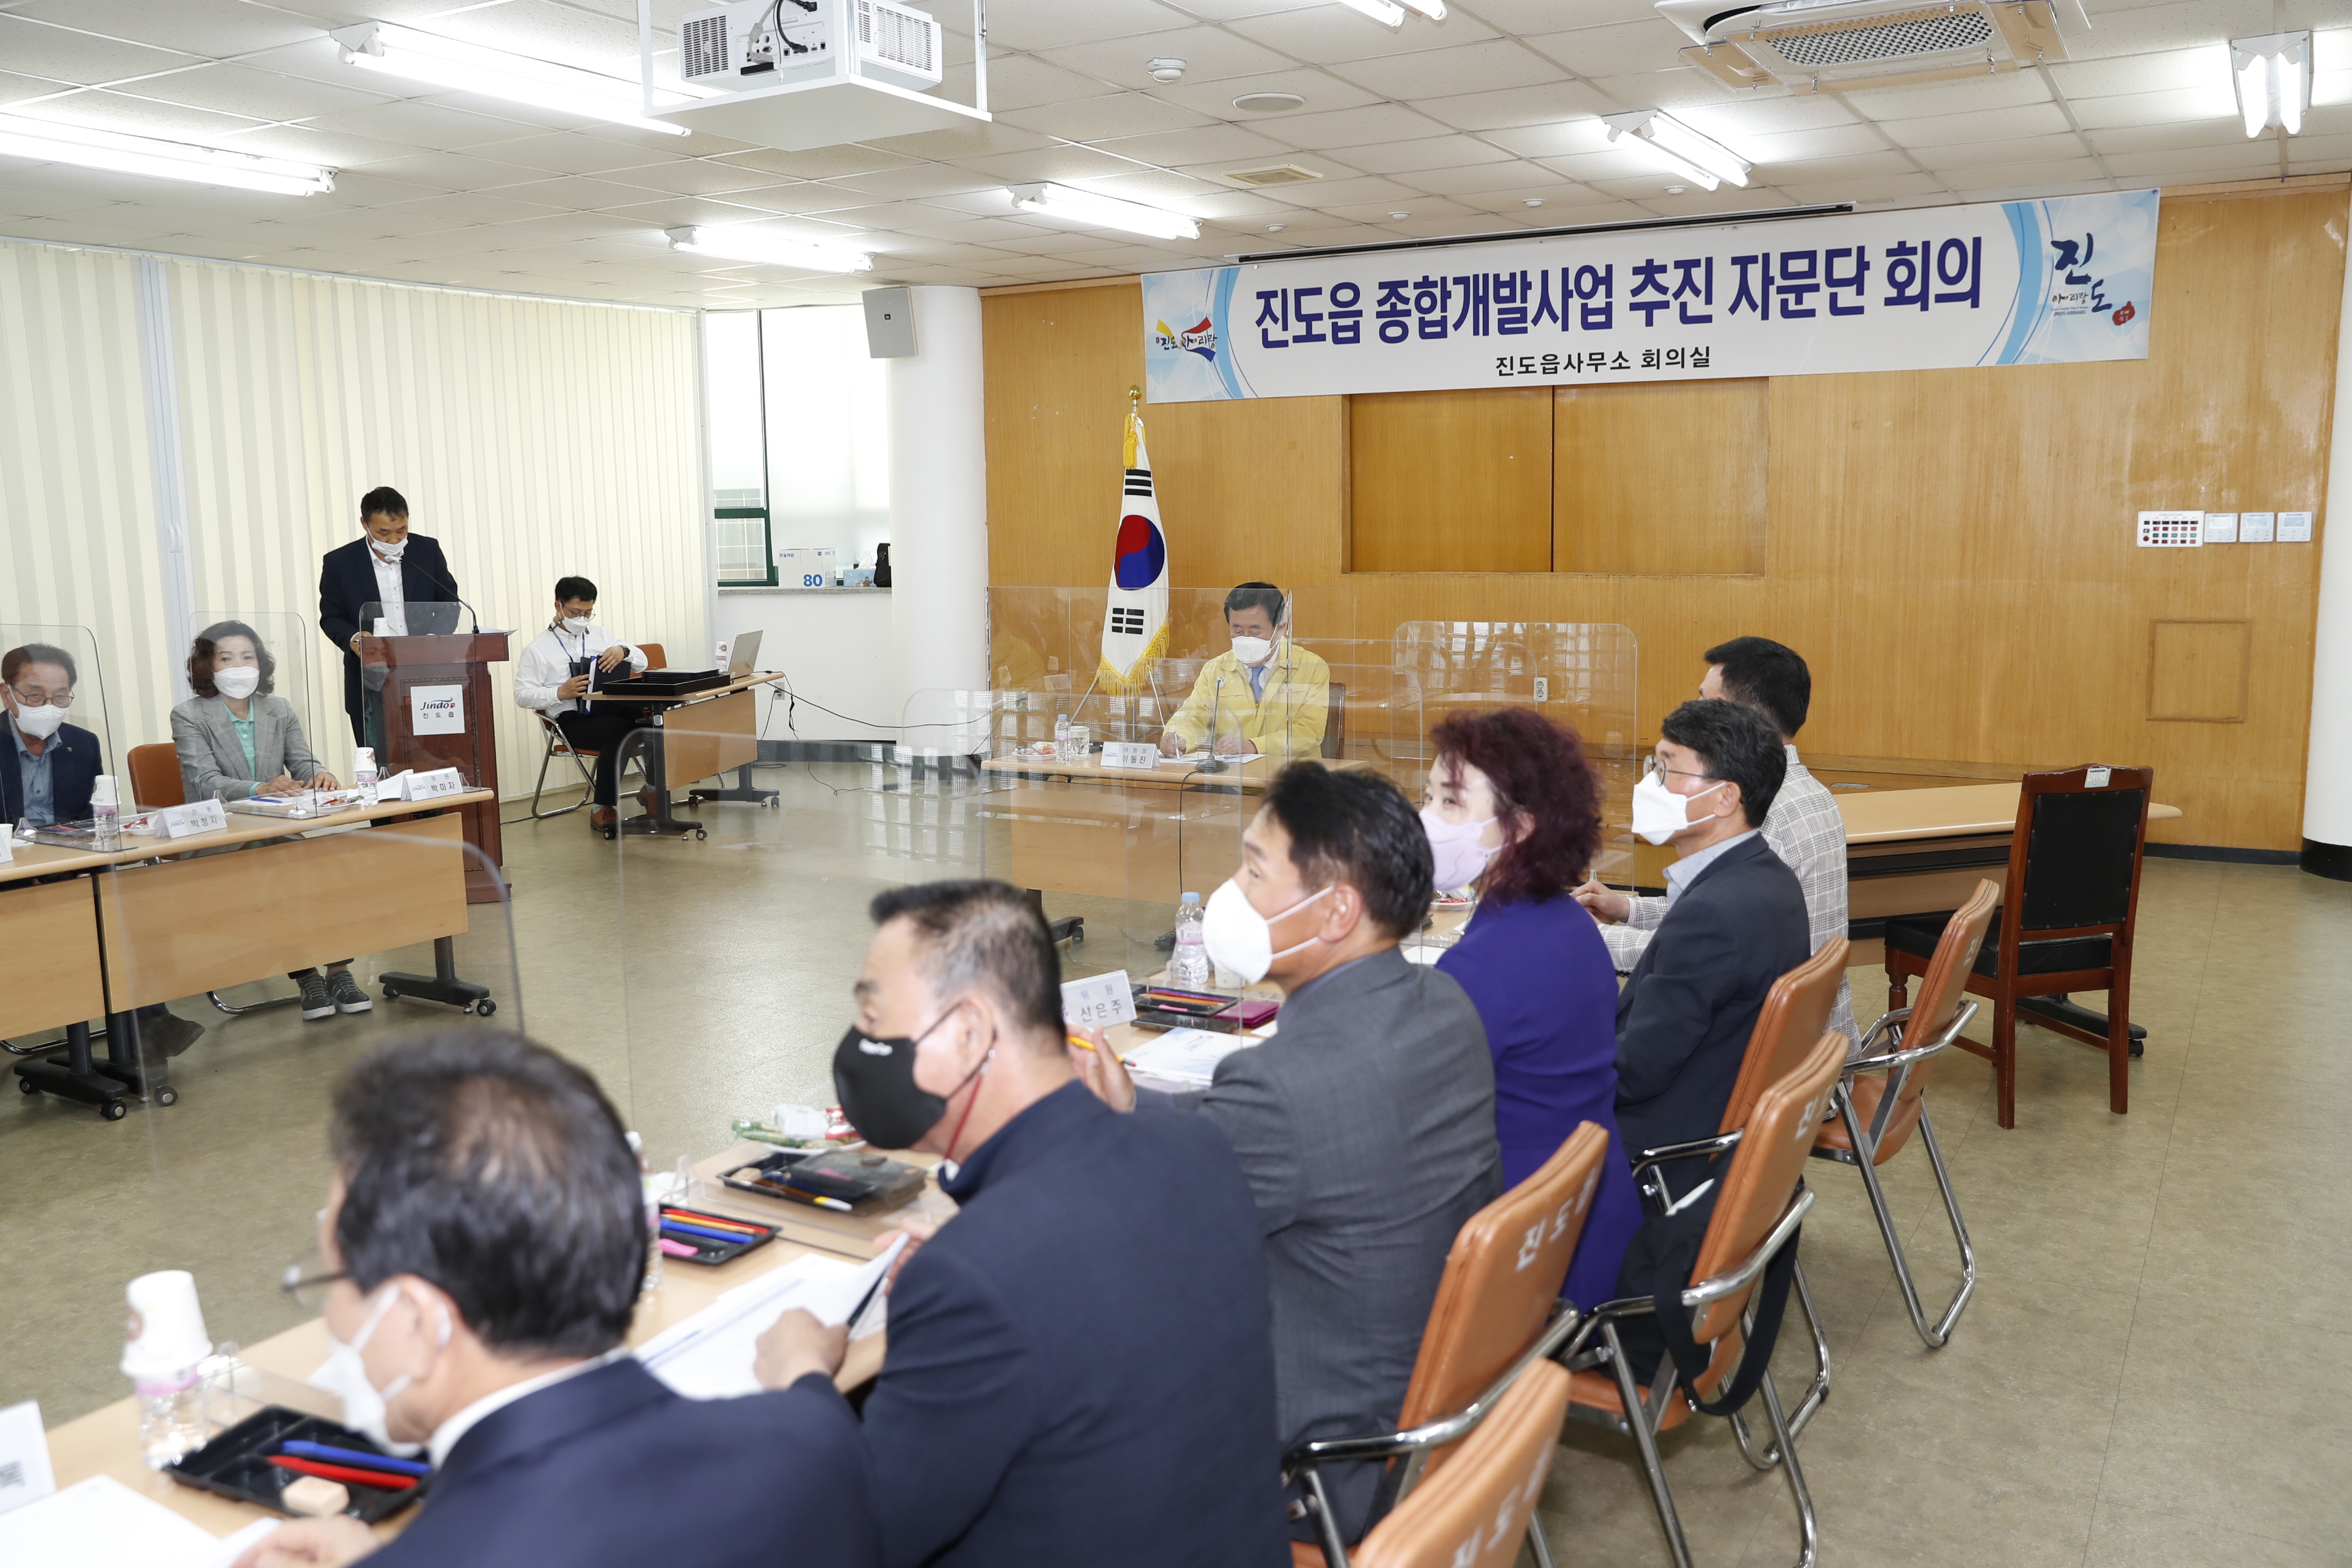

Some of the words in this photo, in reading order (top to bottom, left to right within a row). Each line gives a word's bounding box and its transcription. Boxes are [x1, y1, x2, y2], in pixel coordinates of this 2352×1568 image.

[1255, 282, 1363, 349] 진도읍
[1375, 264, 1613, 344] 종합개발사업
[1629, 256, 1713, 328] 추진
[1728, 245, 1870, 321] 자문단
[1884, 236, 1982, 312] 회의
[1496, 351, 1631, 377] 진도읍사무소
[1641, 346, 1710, 370] 회의실
[803, 574, 823, 587] 80
[420, 701, 449, 710] Jindo
[1122, 755, 1146, 764] 이동진
[431, 781, 455, 792] 박미자
[1080, 999, 1122, 1023] 신은주
